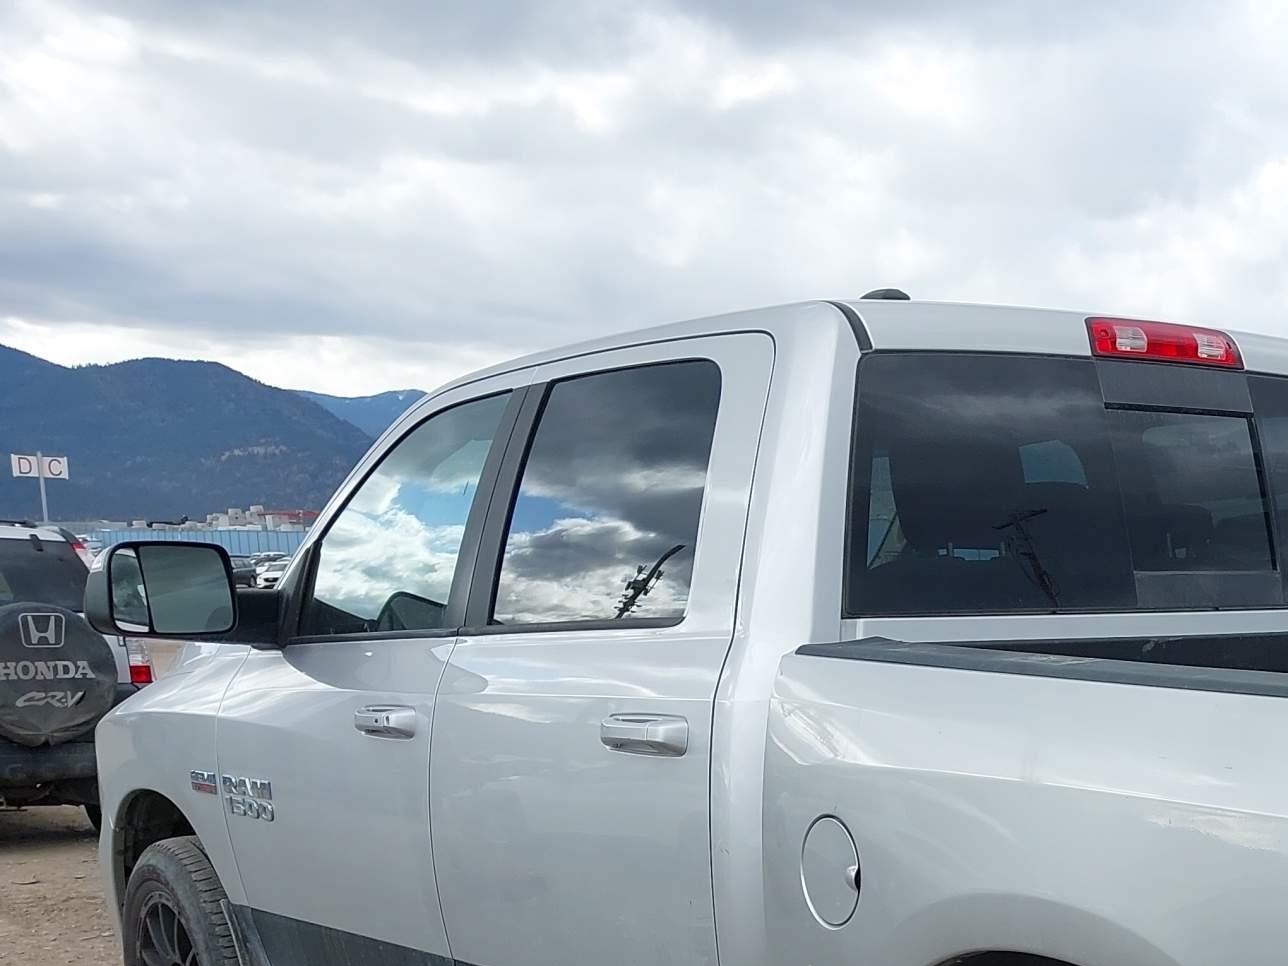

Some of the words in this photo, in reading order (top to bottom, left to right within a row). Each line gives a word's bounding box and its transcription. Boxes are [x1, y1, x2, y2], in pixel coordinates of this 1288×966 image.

[17, 456, 33, 475] D
[47, 458, 63, 477] C
[0, 660, 97, 680] HONDA
[221, 774, 273, 801] RAM
[225, 796, 275, 822] 1500
